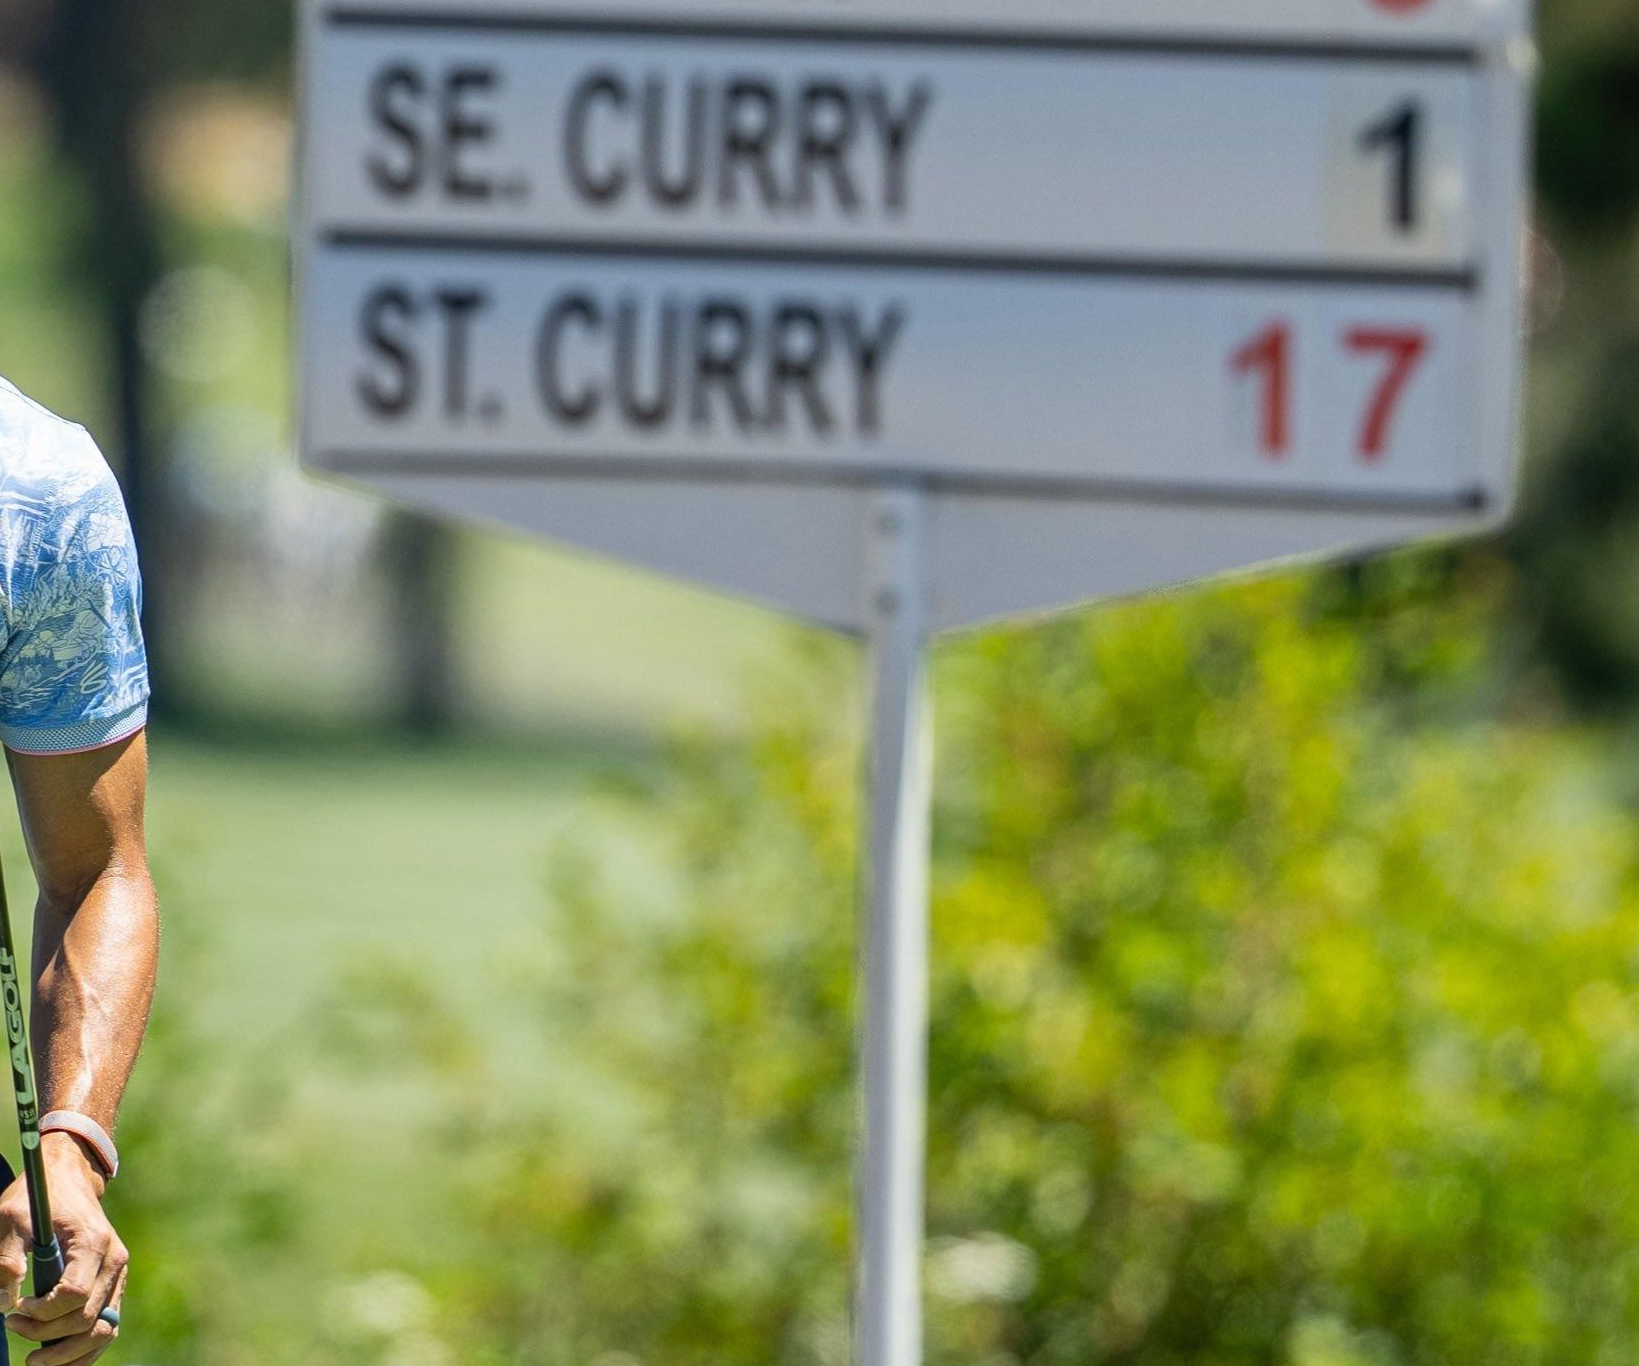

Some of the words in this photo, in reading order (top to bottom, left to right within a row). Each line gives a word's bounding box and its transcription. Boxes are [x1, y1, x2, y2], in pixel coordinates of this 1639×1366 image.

[368, 64, 529, 205] SE.
[564, 69, 932, 221] CURRY
[1357, 95, 1426, 234] 1
[359, 286, 502, 423] ST.
[534, 291, 904, 438] CURRY
